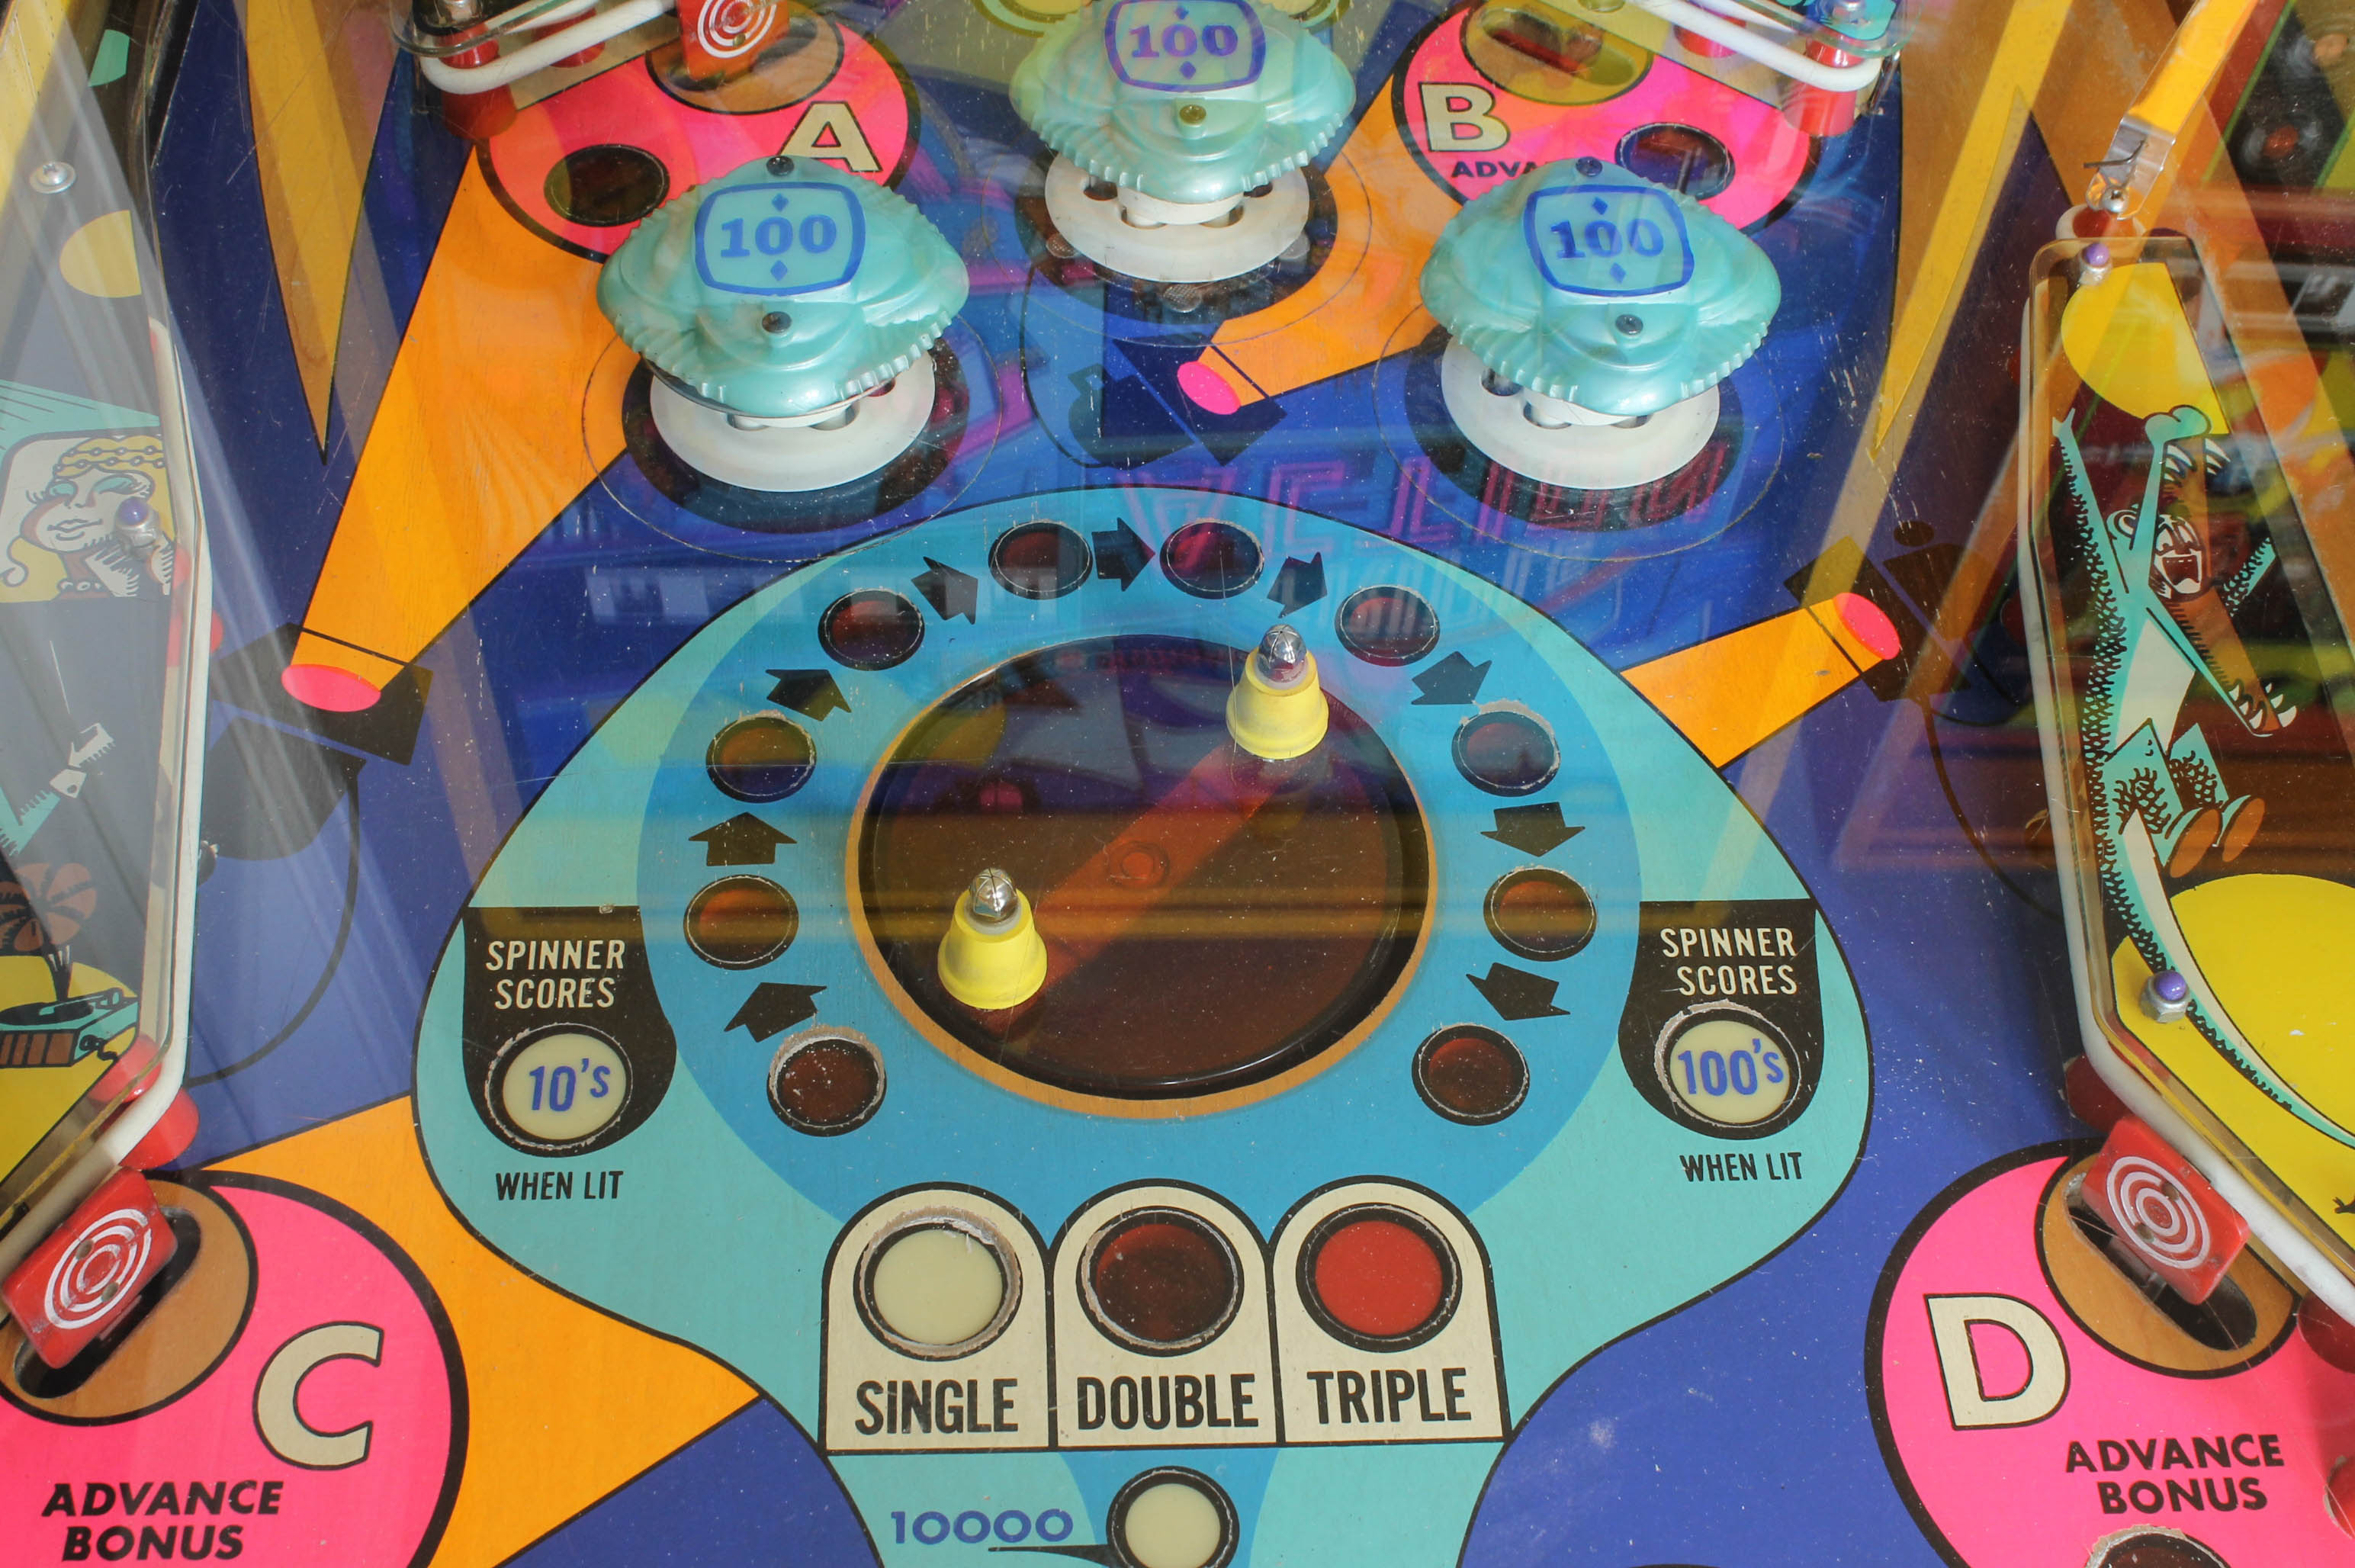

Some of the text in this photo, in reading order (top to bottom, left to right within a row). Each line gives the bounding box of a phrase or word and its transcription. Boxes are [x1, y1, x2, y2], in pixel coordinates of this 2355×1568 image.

[1129, 24, 1239, 58] 100
[779, 101, 883, 172] A
[1418, 82, 1511, 153] B
[721, 214, 837, 258] 100
[1550, 218, 1664, 259] 100
[485, 939, 625, 972] SPINNER
[1659, 927, 1798, 959] SPINNER
[494, 977, 616, 1010] SCORES
[1677, 965, 1798, 996] SCORES
[496, 1170, 625, 1200] WHEN LIT
[1679, 1152, 1803, 1182] WHEN LIT
[1923, 1293, 2071, 1431] D
[252, 1321, 385, 1471] C
[854, 1378, 1019, 1435] SINGLE
[1077, 1373, 1259, 1431] DOUBLE
[1306, 1367, 1473, 1425] TRIPLE
[2065, 1433, 2285, 1473] ADVANCE
[41, 1480, 284, 1517] ADVANCE
[2096, 1476, 2268, 1515] BONUS
[62, 1525, 245, 1562] BONUS
[891, 1508, 1074, 1546] 10000
